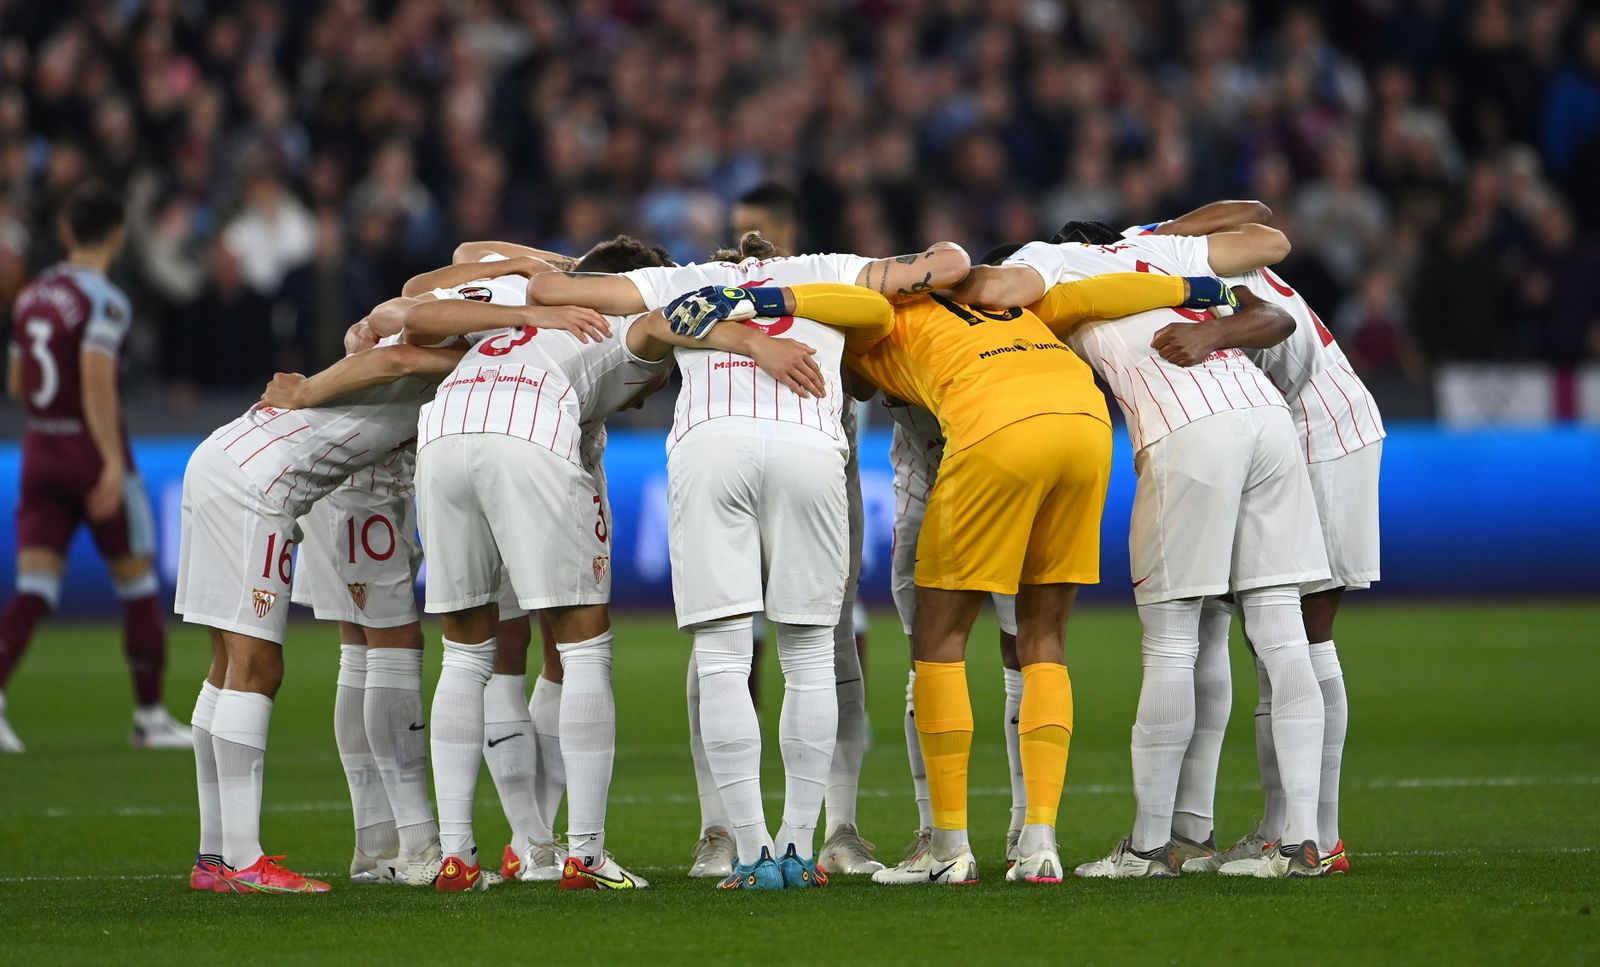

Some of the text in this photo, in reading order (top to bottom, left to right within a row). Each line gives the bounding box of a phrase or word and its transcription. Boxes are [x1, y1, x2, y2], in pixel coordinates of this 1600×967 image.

[27, 317, 60, 409] 3
[714, 360, 754, 370] Manos
[979, 346, 1015, 359] Manos
[498, 375, 538, 387] Unidas
[347, 514, 396, 564] 10
[592, 495, 608, 543] 3
[262, 532, 293, 584] 16
